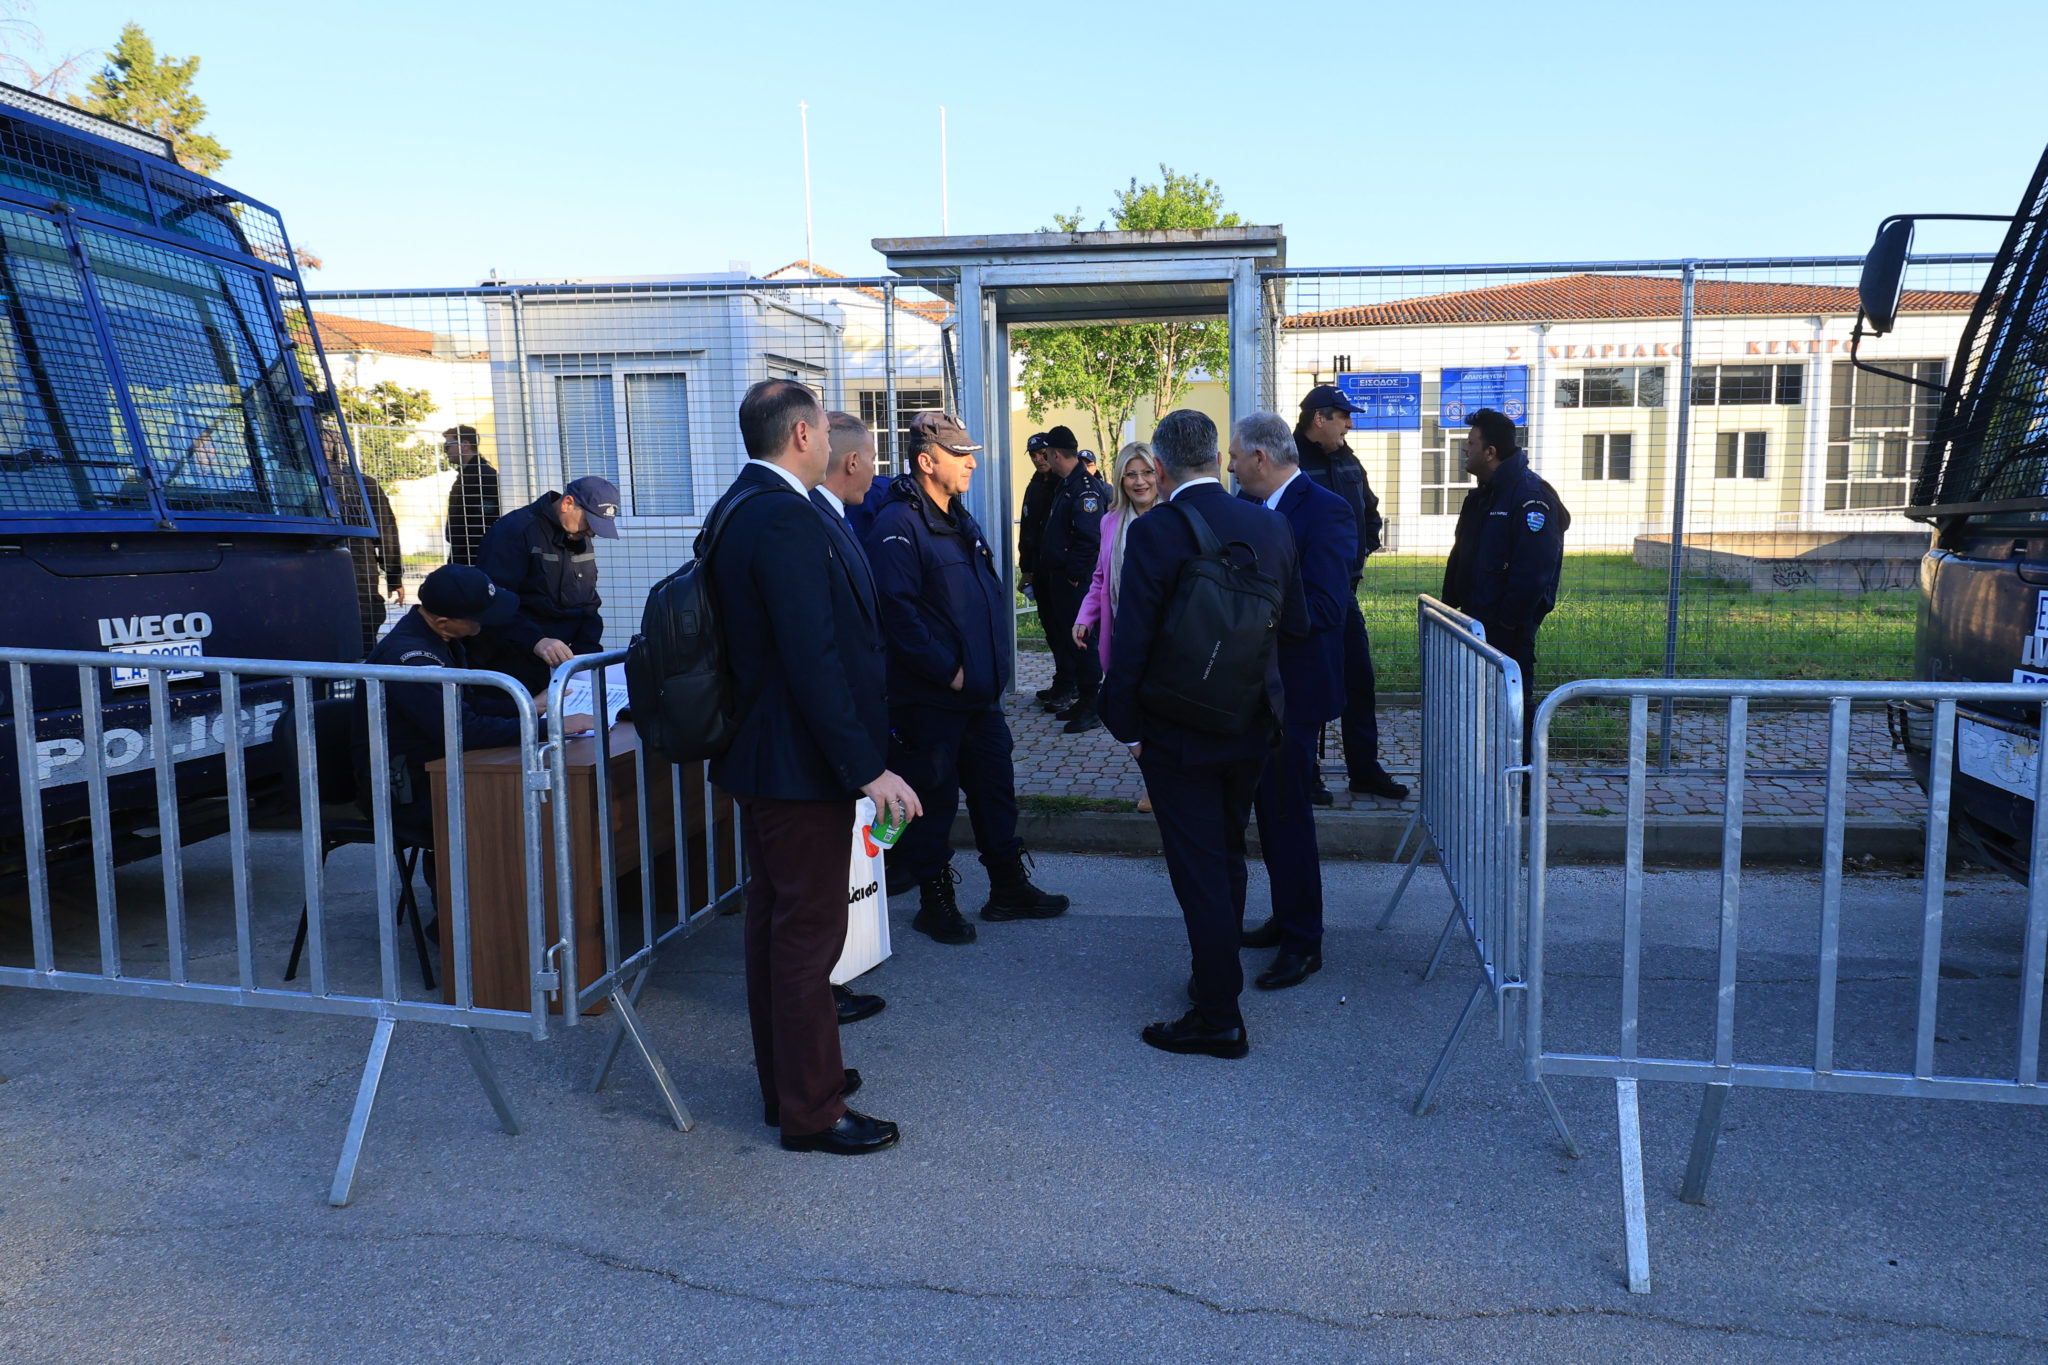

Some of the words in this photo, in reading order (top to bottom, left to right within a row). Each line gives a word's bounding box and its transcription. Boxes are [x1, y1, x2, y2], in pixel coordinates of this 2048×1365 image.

[1507, 342, 1684, 360] ΣΝΕΔΡΙΑΚΟ
[1359, 378, 1399, 387] ΕΙΣΟΔΟΣ
[98, 611, 213, 646] IVECO
